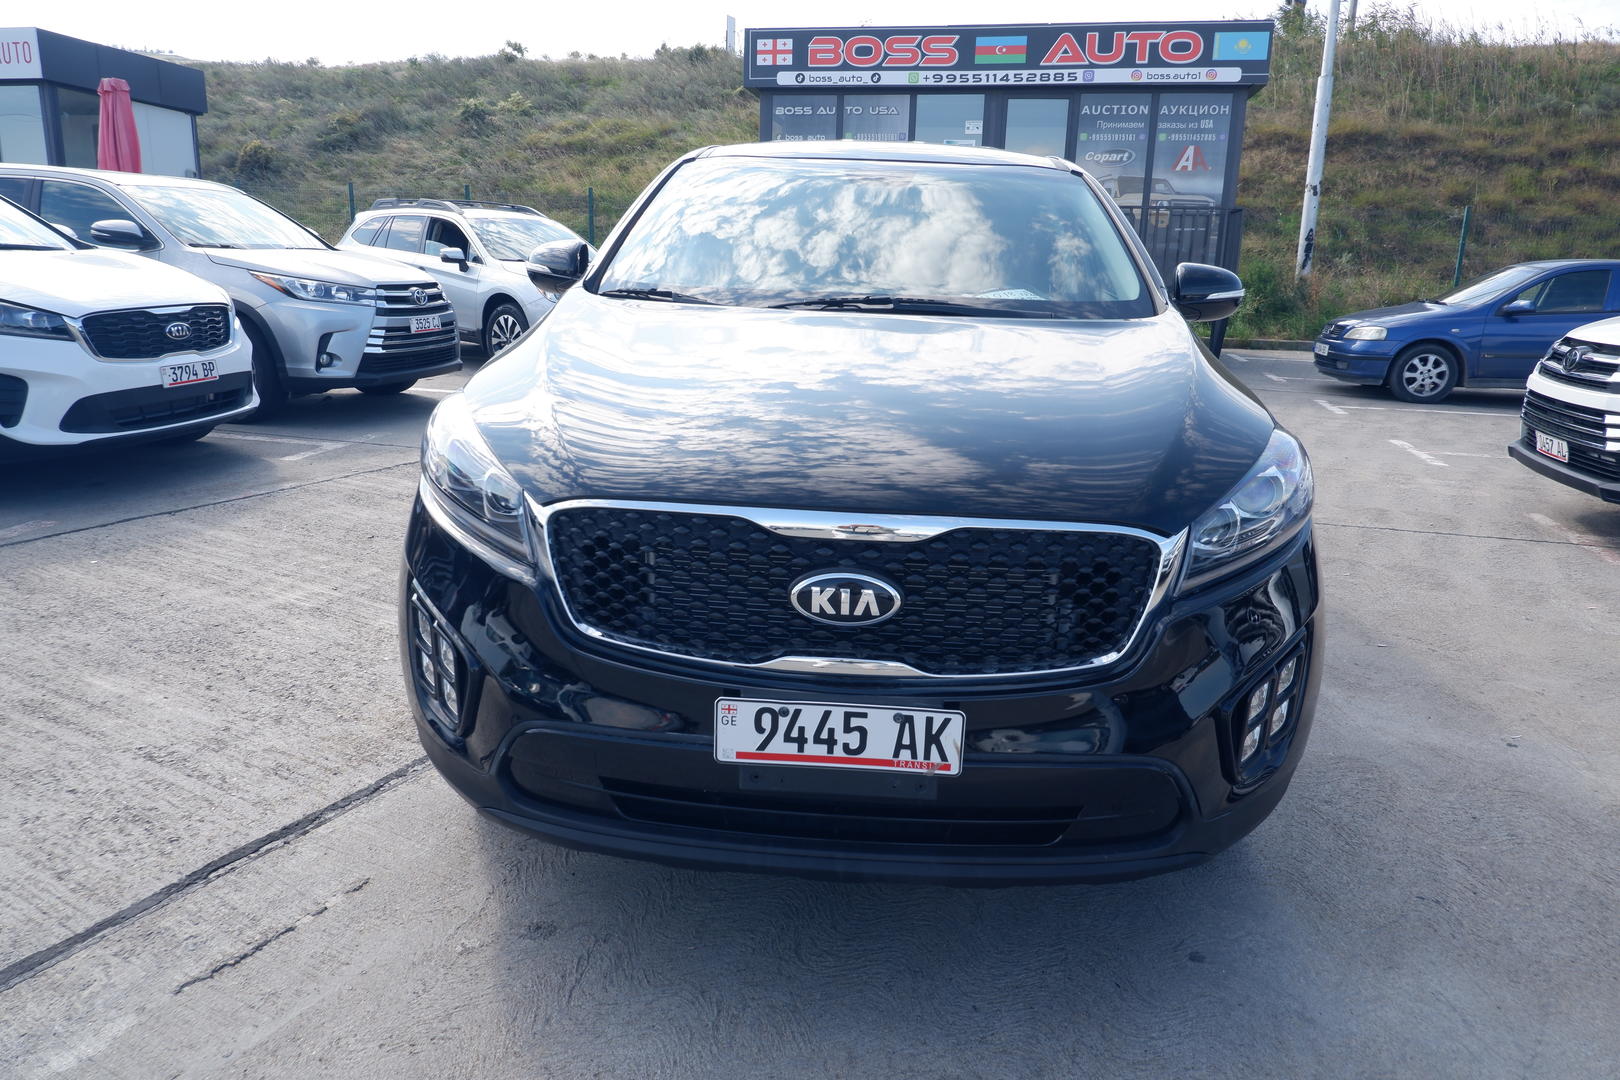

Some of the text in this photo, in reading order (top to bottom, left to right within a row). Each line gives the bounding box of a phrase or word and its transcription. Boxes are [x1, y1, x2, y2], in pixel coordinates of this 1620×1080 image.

[0, 41, 32, 64] UTO
[807, 30, 1204, 67] BOSS AUTO
[922, 71, 1079, 84] +995511452885
[775, 106, 813, 115] BOSS
[869, 106, 899, 115] USA
[1081, 104, 1149, 115] AUCTION
[1159, 104, 1230, 116] АУКЦИОН
[1096, 120, 1145, 129] Принимаем
[1158, 121, 1187, 129] заказы
[1200, 119, 1214, 128] USA
[1084, 151, 1130, 163] Copart
[415, 317, 431, 330] 3525
[170, 325, 190, 337] KIA
[169, 361, 215, 383] 3794 BP
[810, 586, 881, 617] KIA
[720, 715, 737, 727] GE
[753, 706, 953, 763] 9445 AK
